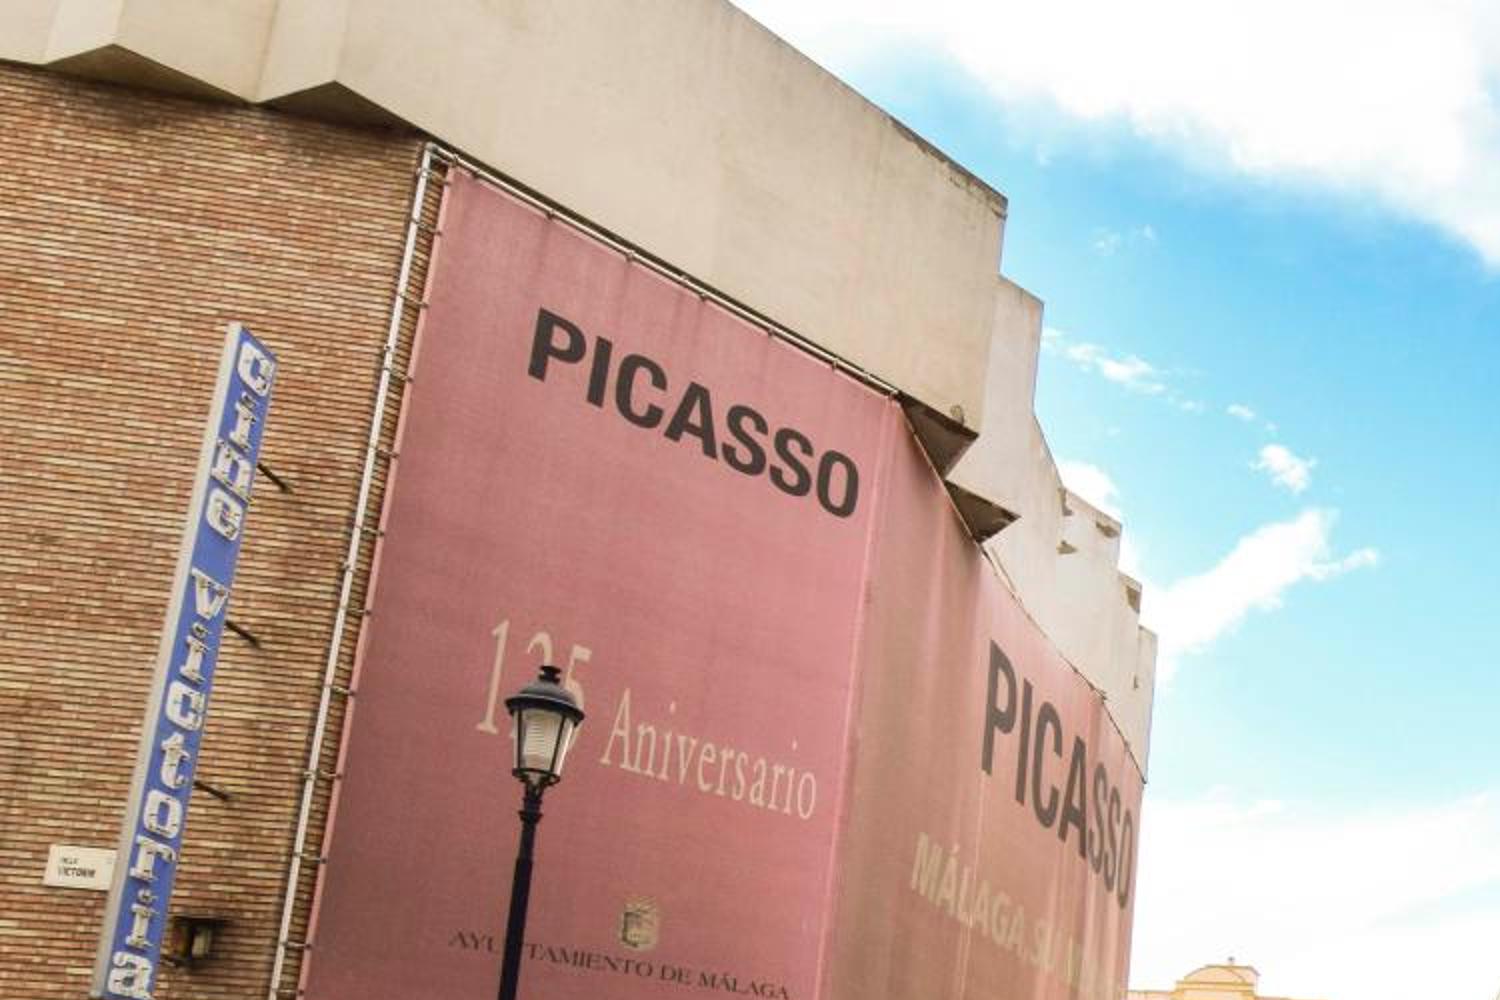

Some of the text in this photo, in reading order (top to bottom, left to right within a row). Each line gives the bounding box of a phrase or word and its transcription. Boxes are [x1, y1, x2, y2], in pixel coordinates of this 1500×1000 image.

[528, 307, 859, 519] PICASSO
[600, 687, 818, 821] Aniversario
[981, 639, 1134, 910] PICASSO
[660, 966, 693, 987] DE
